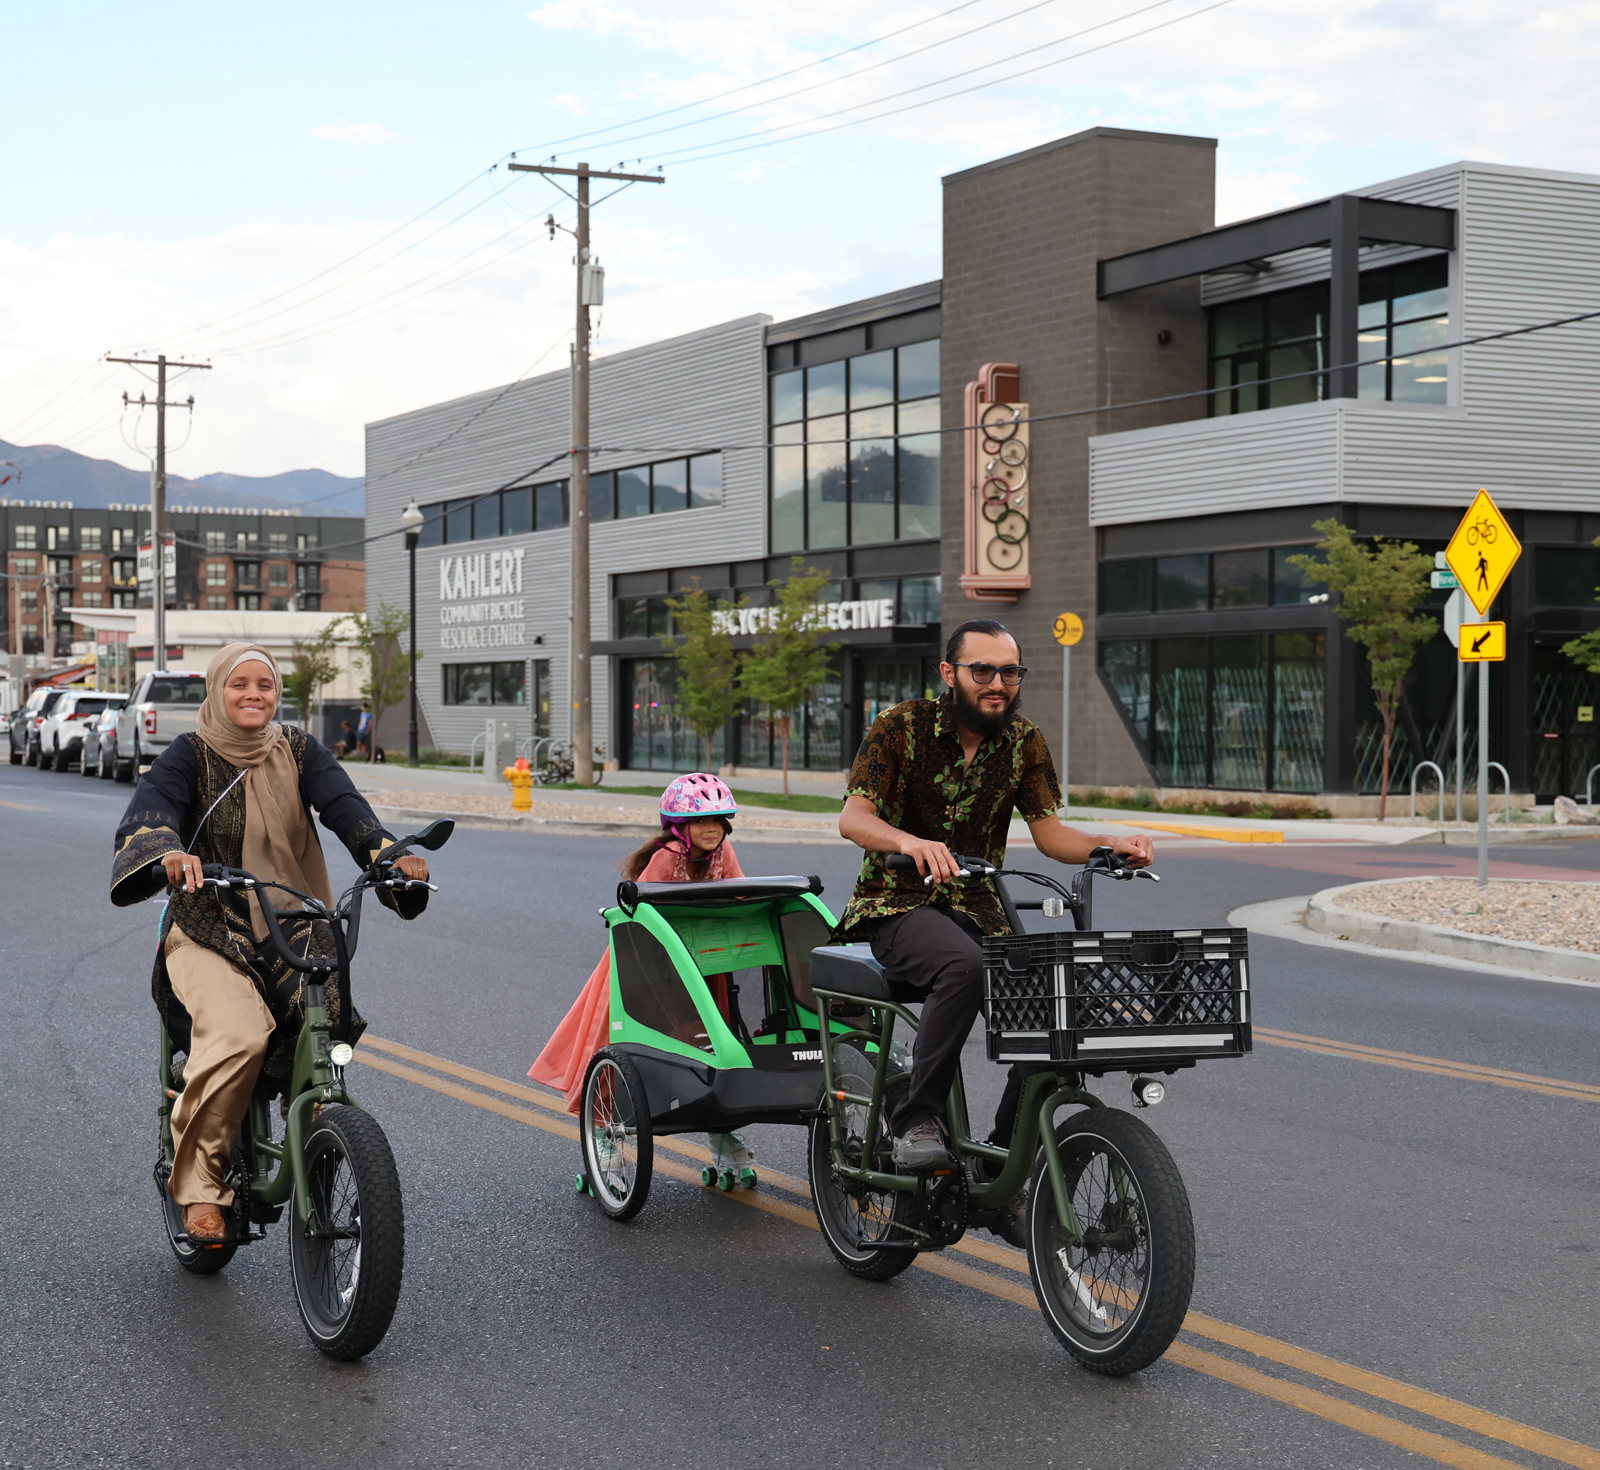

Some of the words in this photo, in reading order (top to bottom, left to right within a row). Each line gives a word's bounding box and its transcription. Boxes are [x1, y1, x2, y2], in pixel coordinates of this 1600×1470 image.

[440, 548, 525, 600] KAHLERT
[441, 602, 490, 625] COMMUNITY
[489, 623, 525, 647] CENTER
[1054, 618, 1066, 639] 9
